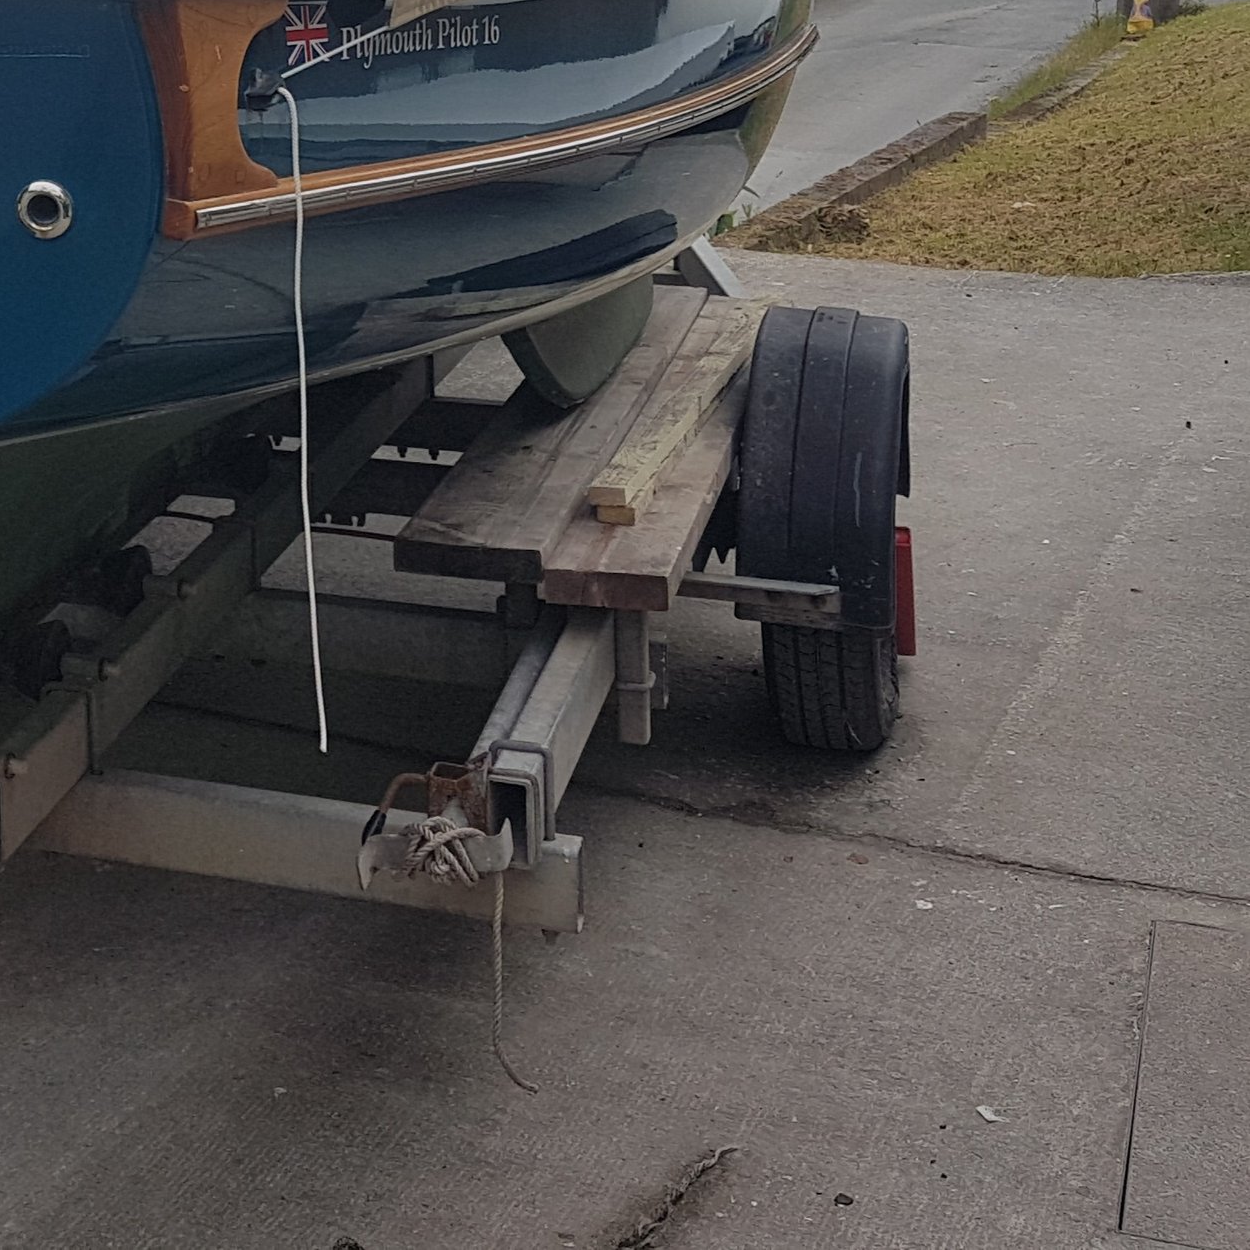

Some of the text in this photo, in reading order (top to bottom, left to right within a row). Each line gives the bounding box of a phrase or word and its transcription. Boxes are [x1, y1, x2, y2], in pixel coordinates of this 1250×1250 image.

[340, 14, 500, 69] Plymouth Pilot 16
